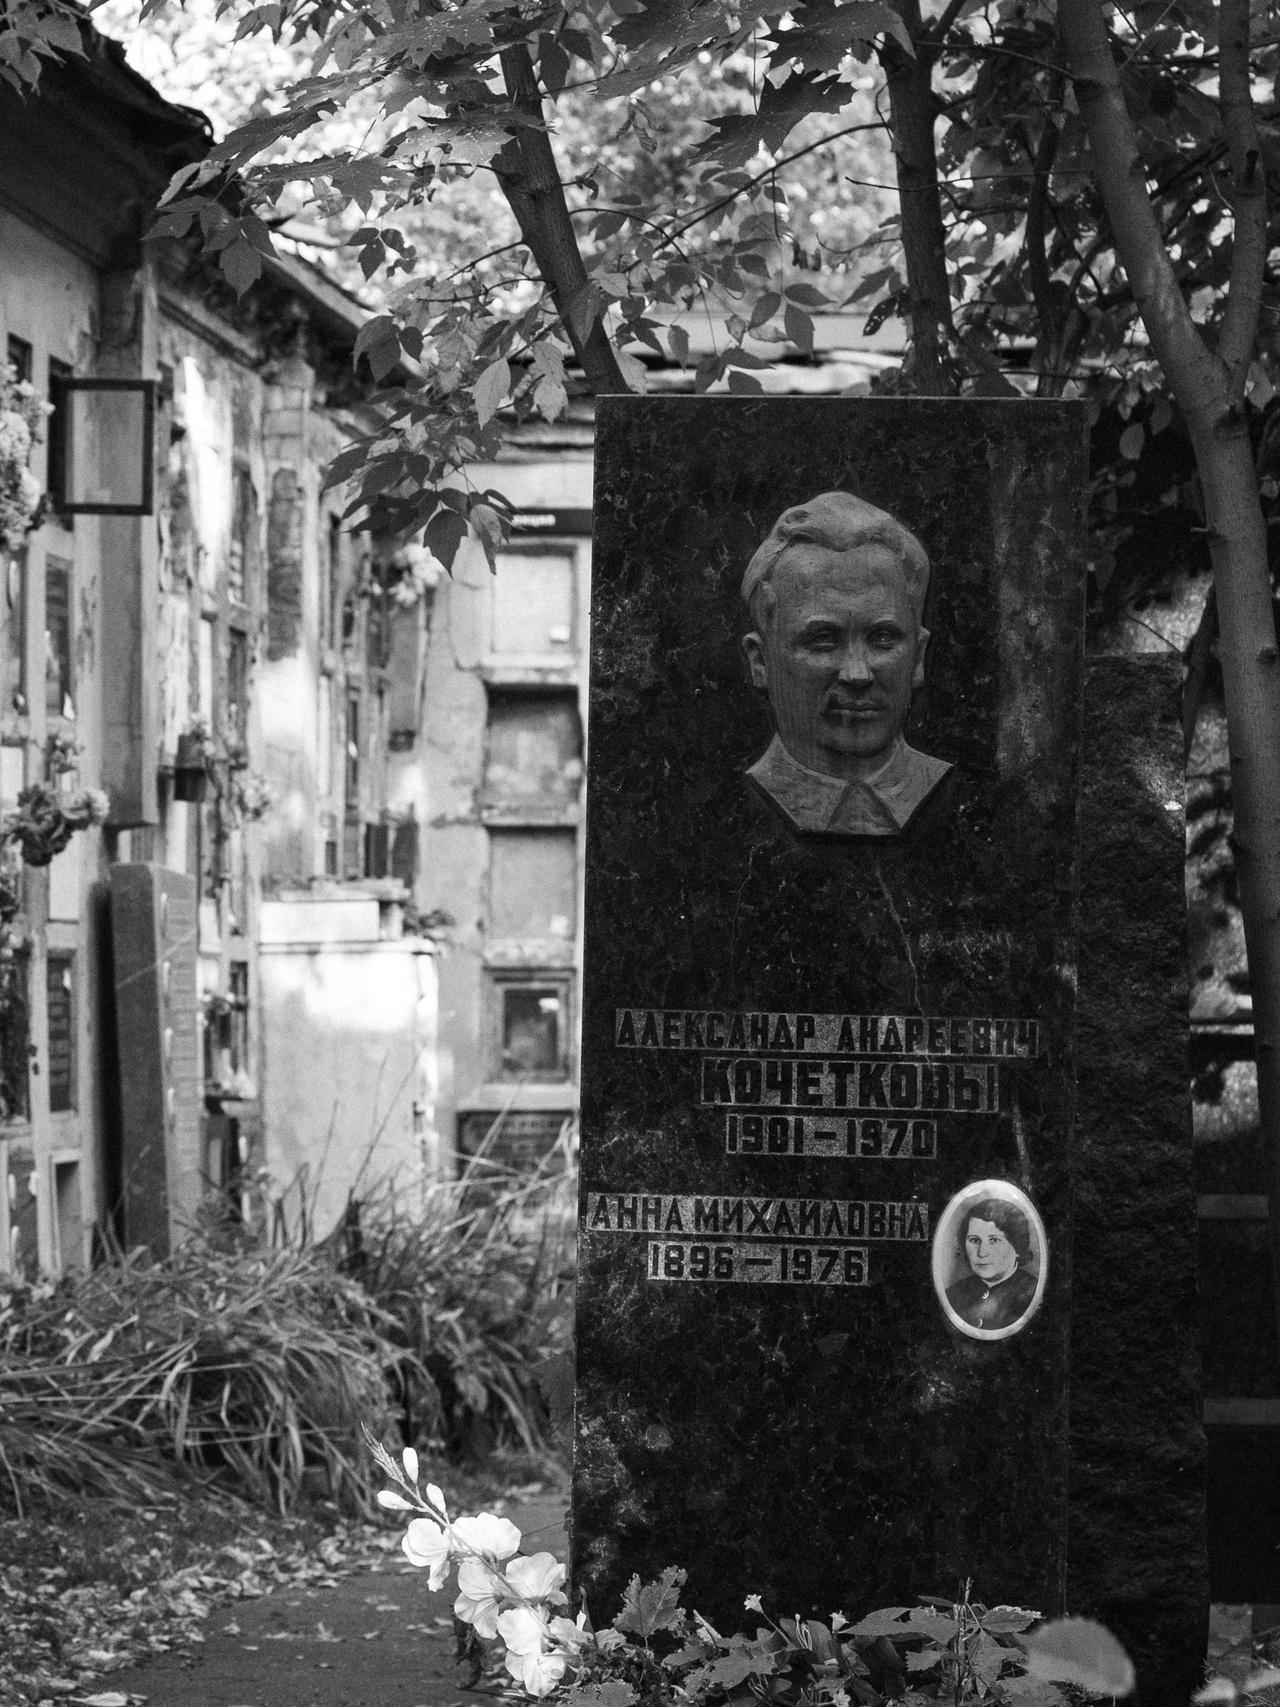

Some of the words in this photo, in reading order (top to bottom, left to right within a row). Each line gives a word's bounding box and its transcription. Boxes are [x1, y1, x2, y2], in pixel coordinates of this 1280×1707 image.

[617, 1009, 816, 1051] АЛЕКСАНДР
[837, 1015, 1038, 1057] АНДРЕЕВИЧ
[703, 1058, 996, 1112] КОЧЕТКОВЫ
[591, 1195, 684, 1232] АННА
